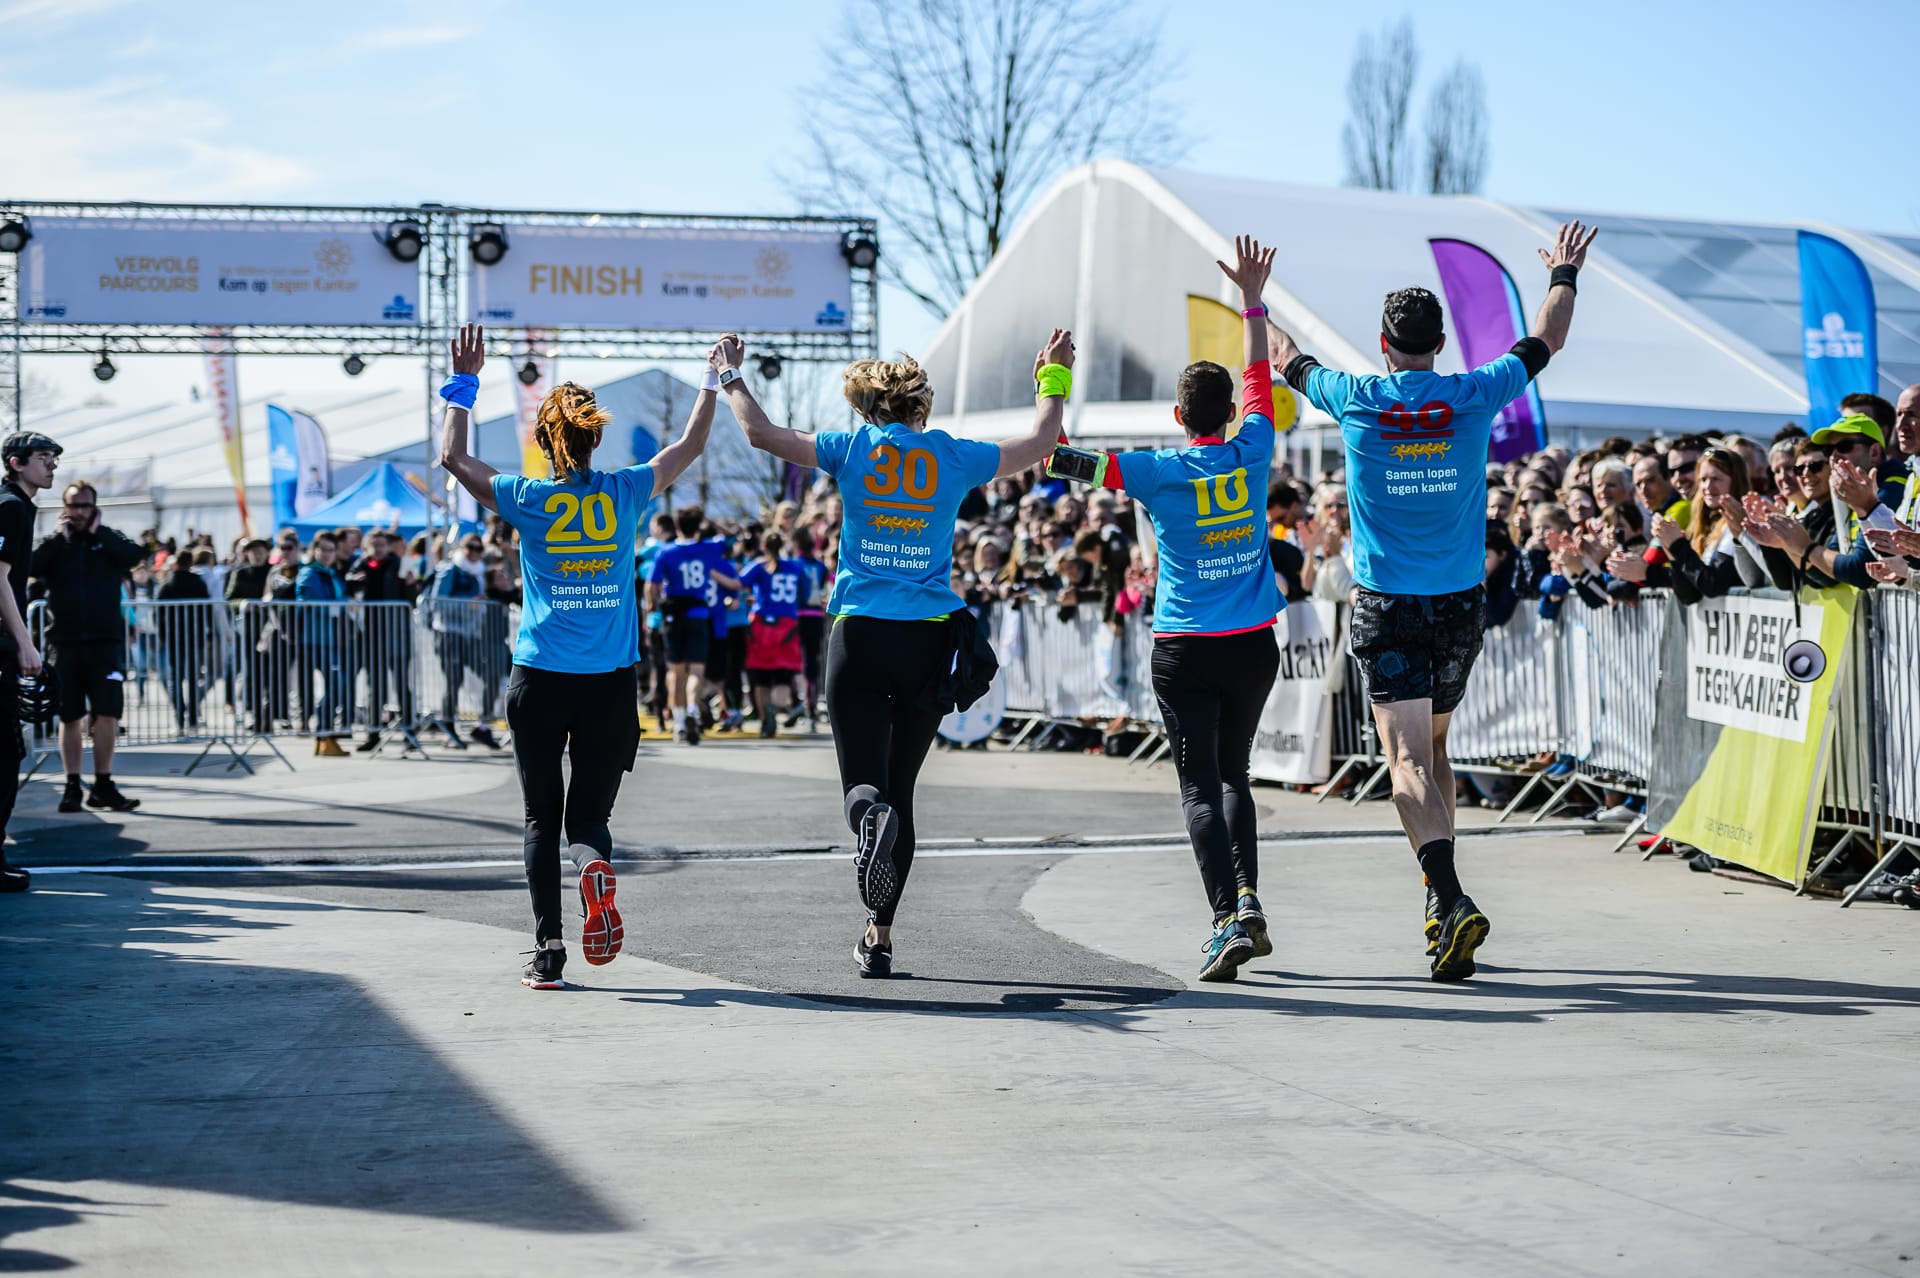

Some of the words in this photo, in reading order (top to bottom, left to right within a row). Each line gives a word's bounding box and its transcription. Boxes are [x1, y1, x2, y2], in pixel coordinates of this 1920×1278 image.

[114, 255, 200, 273] VERVOLG
[98, 273, 200, 293] PARCOURS
[529, 263, 643, 297] FINISH
[863, 444, 939, 500] 30
[1385, 470, 1425, 480] Samen
[1427, 467, 1458, 480] lopen
[1187, 467, 1250, 516] 10
[1386, 484, 1419, 496] tegen
[1421, 481, 1458, 493] kanker
[544, 491, 618, 542] 20
[860, 538, 898, 553] Samen
[900, 543, 931, 557] lopen
[860, 552, 890, 567] tegen
[892, 556, 930, 569] kanker
[1196, 555, 1235, 569] Samen
[1236, 548, 1262, 563] lopen
[679, 560, 705, 590] 18
[1197, 569, 1229, 581] tegen
[551, 585, 589, 596] Samen
[591, 583, 619, 596] lopen
[770, 573, 798, 604] 55
[552, 599, 583, 611] tegen
[585, 597, 621, 609] kanker
